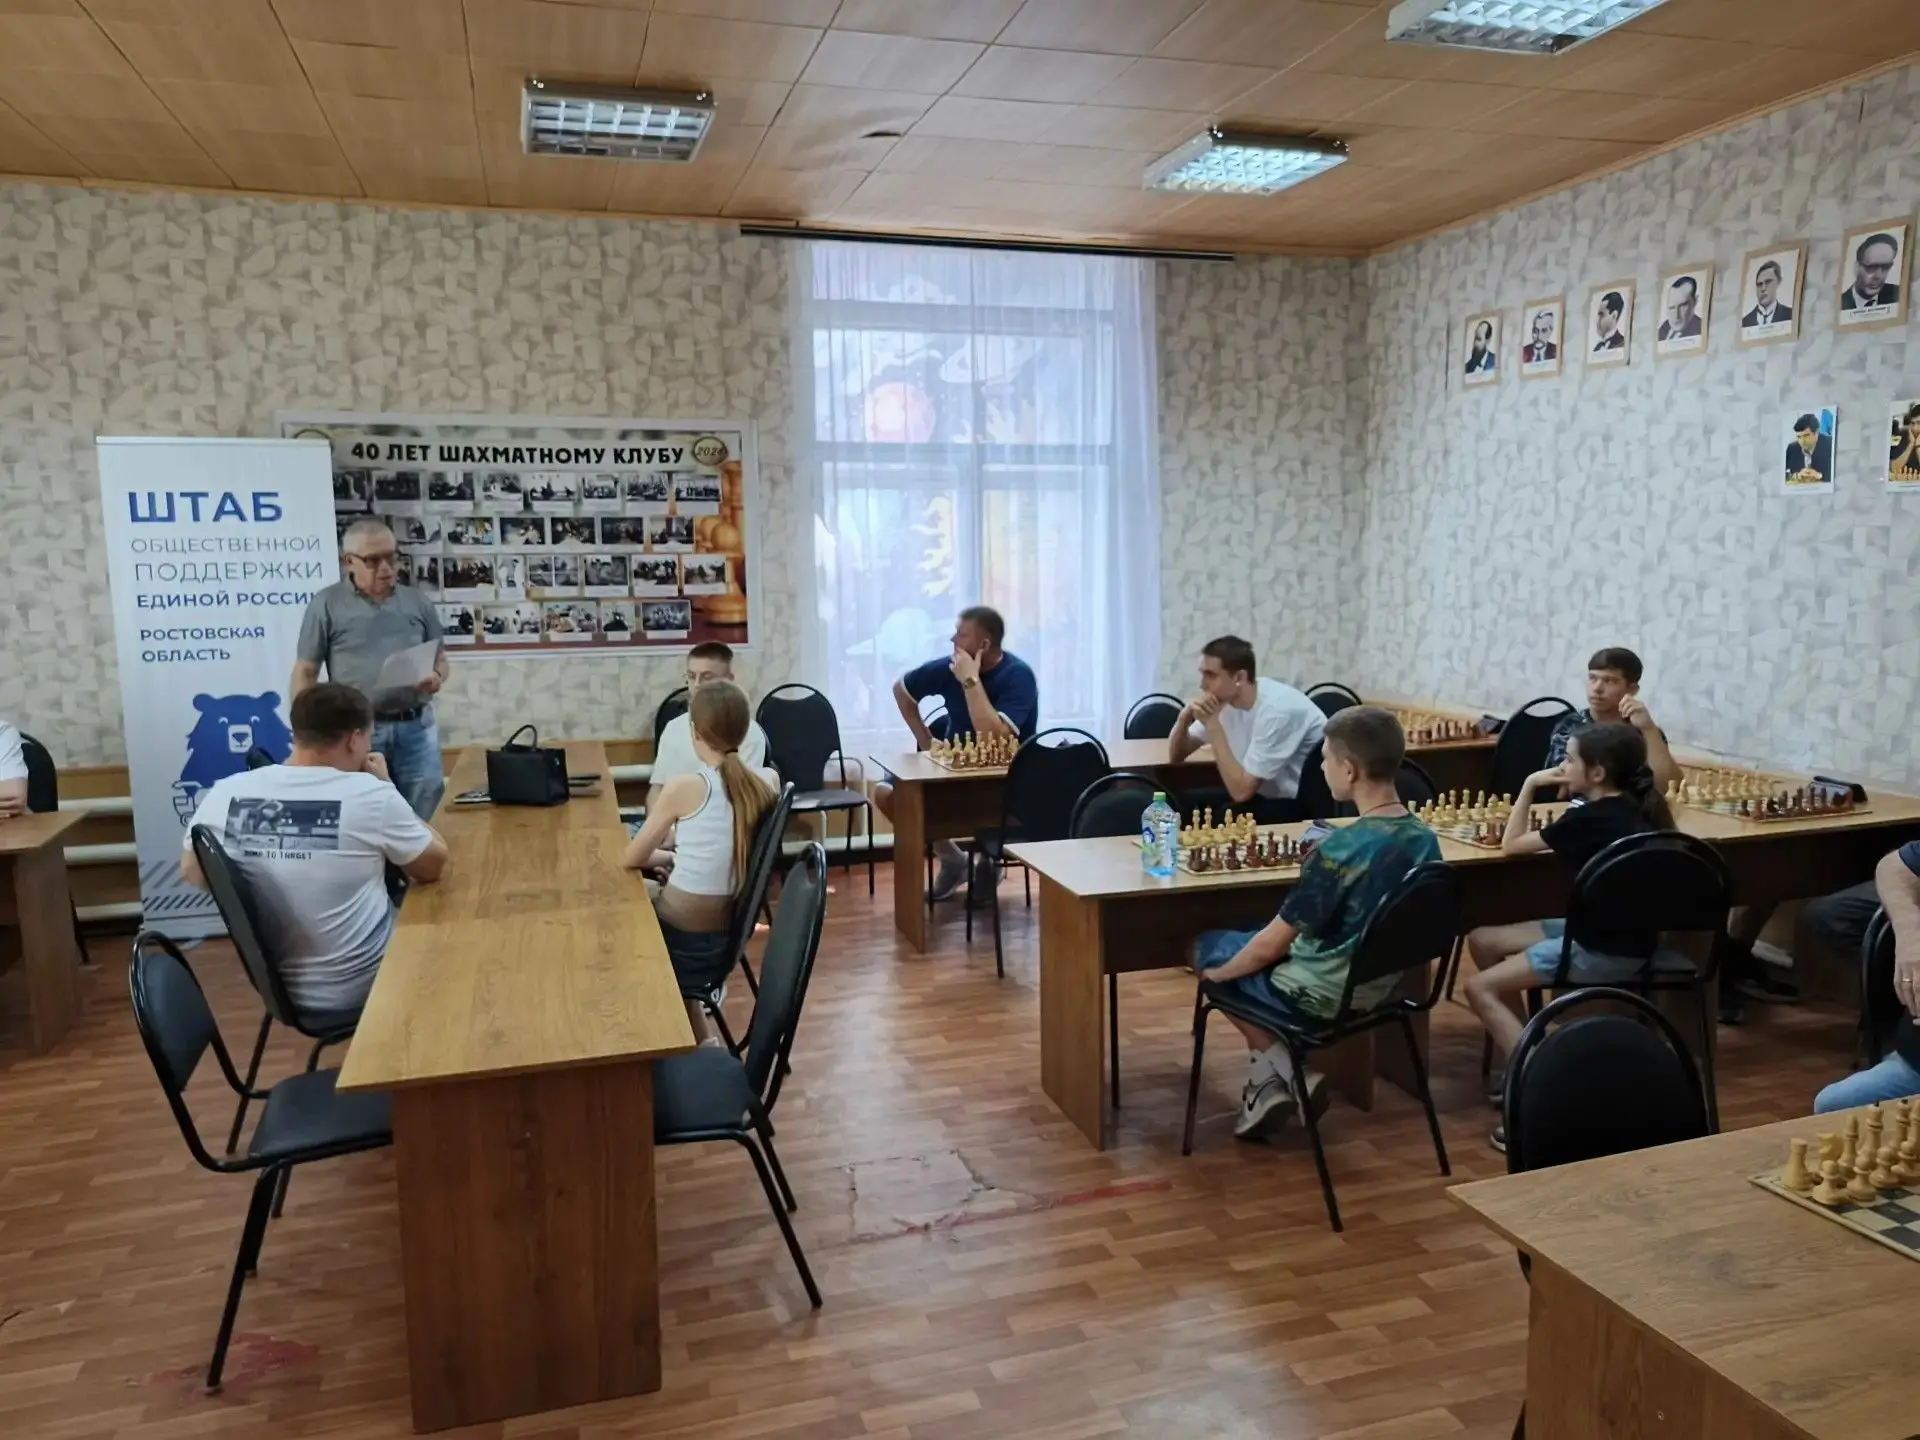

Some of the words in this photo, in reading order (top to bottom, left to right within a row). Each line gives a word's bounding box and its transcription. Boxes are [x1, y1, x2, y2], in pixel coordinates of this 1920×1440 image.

[351, 442, 380, 461] 40
[386, 443, 432, 462] ЛЕТ
[438, 444, 606, 466] ШАХМАТНОМУ
[613, 446, 684, 465] КЛУБУ
[128, 491, 283, 522] ШТАБ
[131, 535, 321, 554] ОБЩЕСТВЕННОЙ
[135, 562, 323, 583] ПОДДЕРЖКИ
[137, 590, 229, 610] ЕДИНОЙ
[140, 626, 265, 641] РОСТОВСКАЯ
[142, 649, 231, 663] ОБЛАСТЬ
